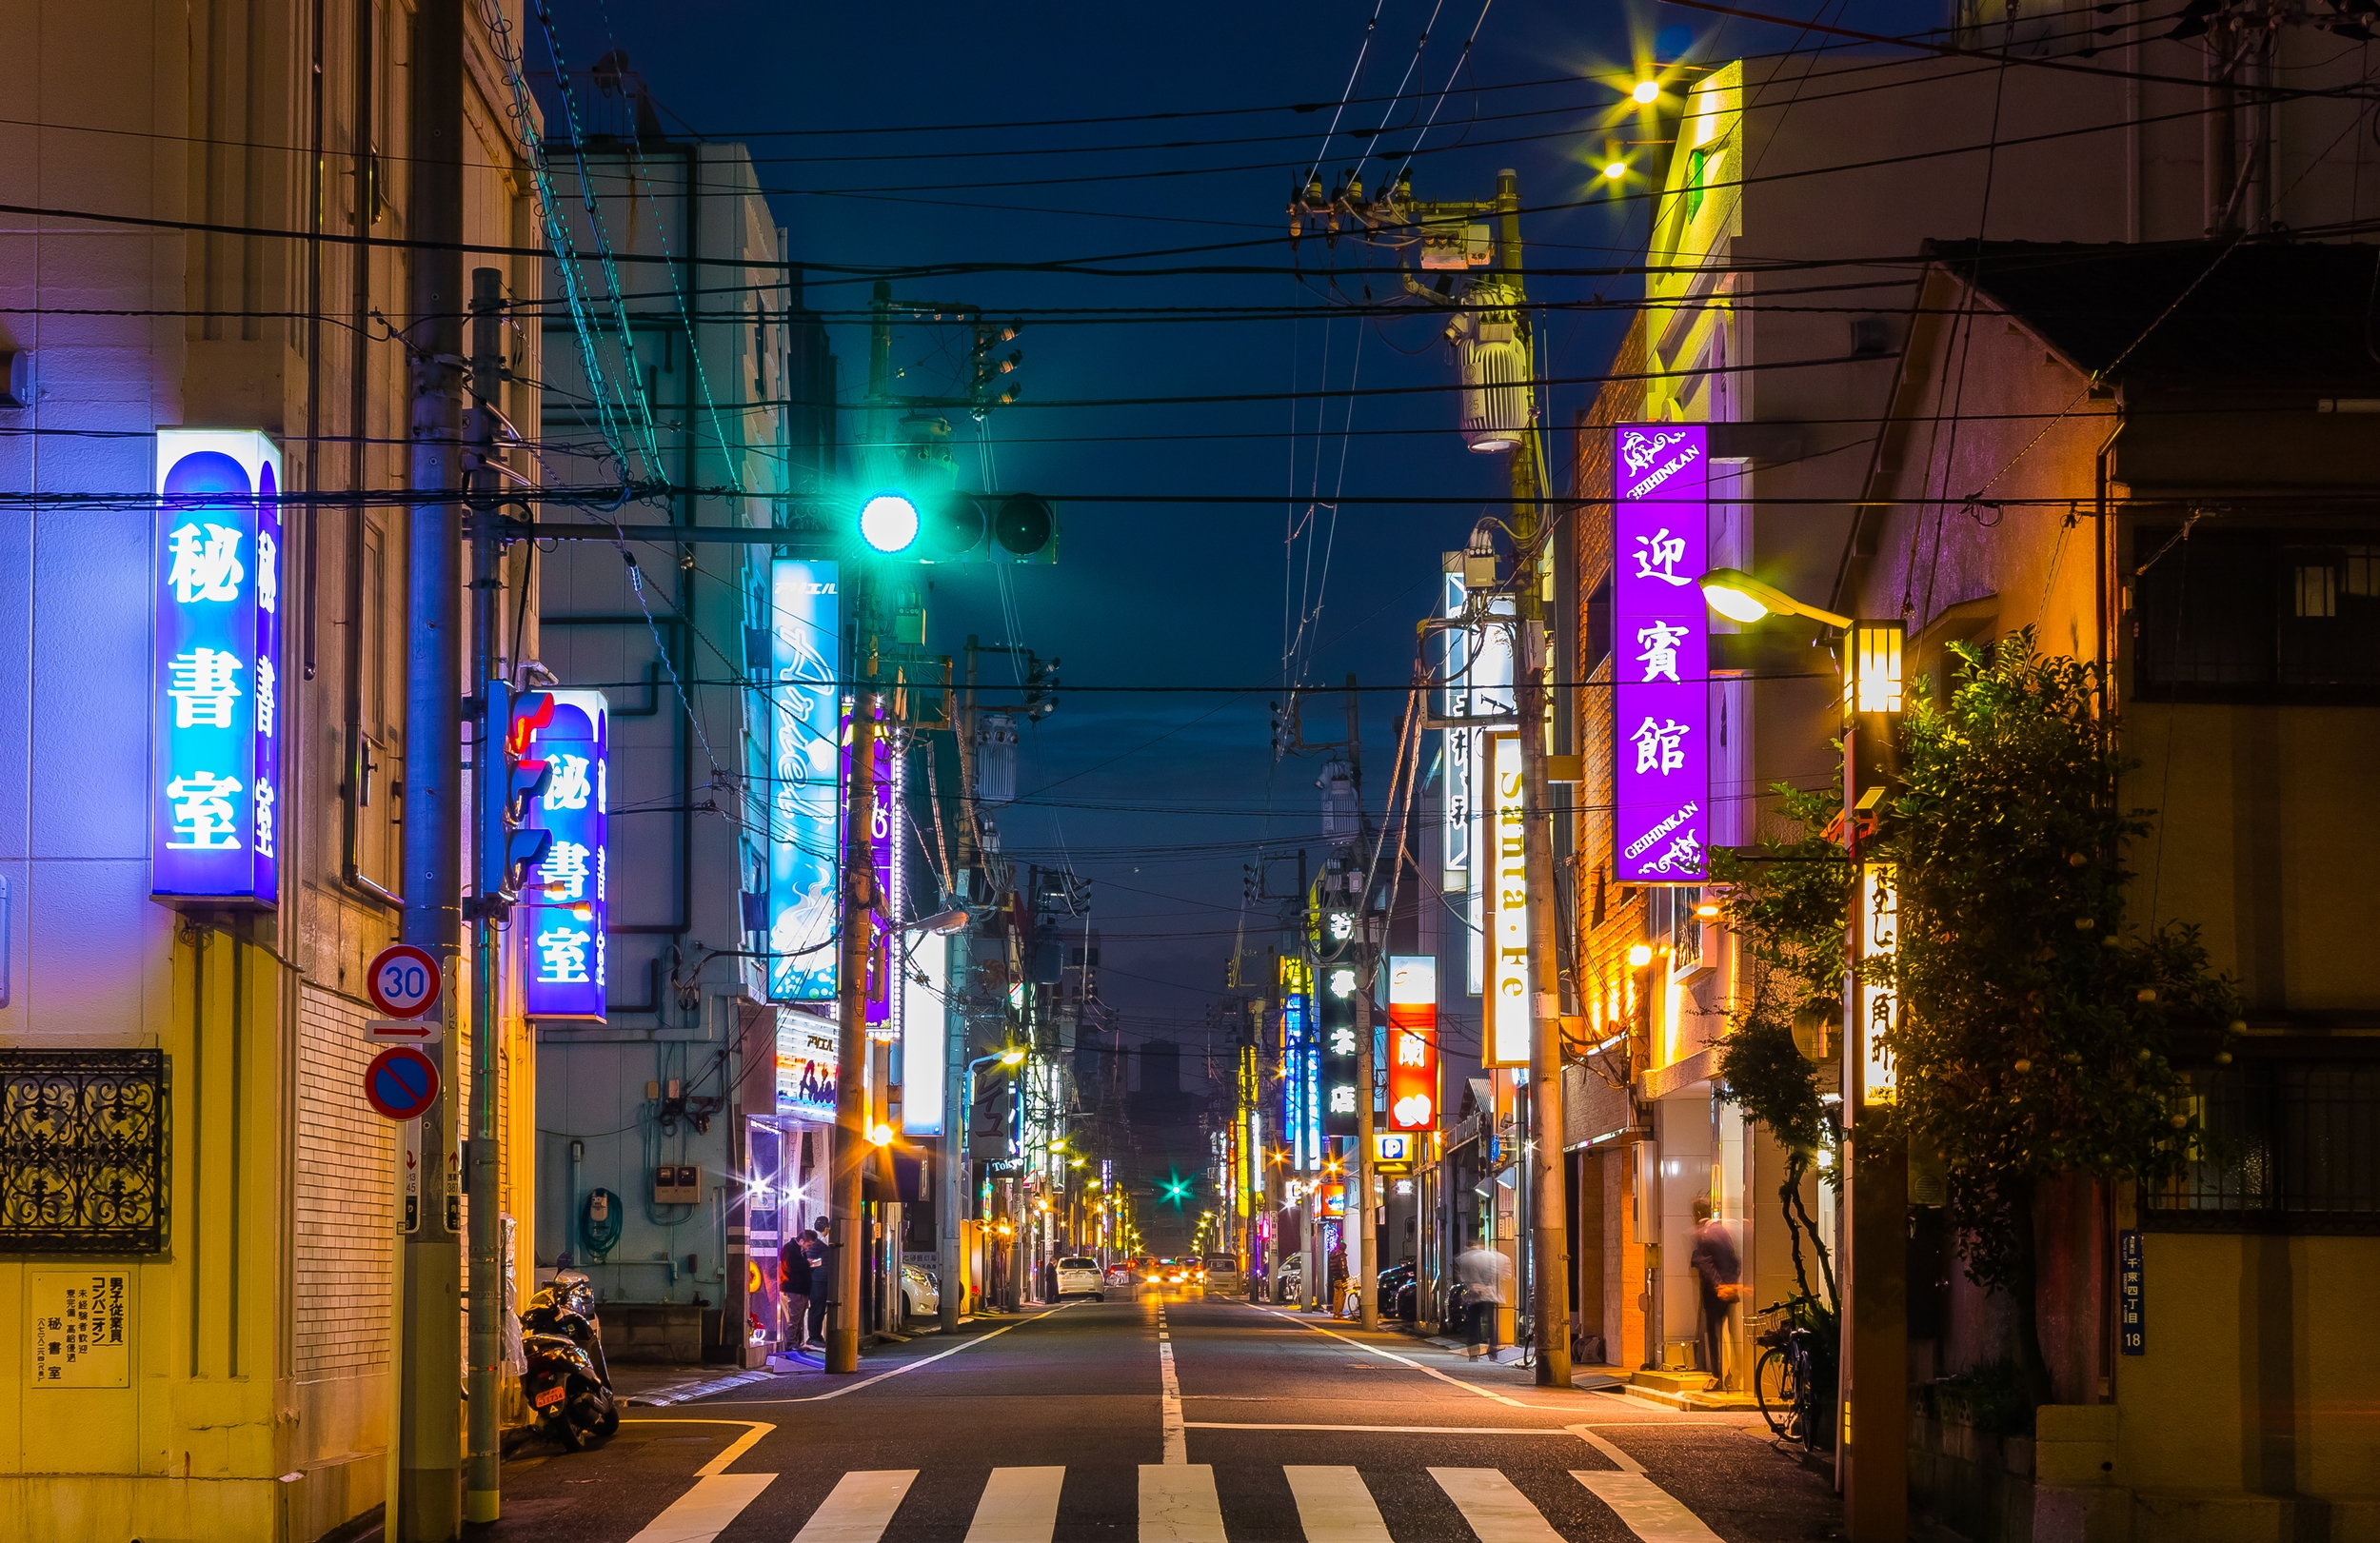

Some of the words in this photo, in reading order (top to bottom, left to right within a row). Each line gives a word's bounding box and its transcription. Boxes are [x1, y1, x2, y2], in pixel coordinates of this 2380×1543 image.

[1626, 444, 1700, 501] GEIHINKAN
[1630, 528, 1693, 777] 迎賓館
[166, 523, 245, 850] 秘書室
[1624, 800, 1699, 860] GEIHINKAN
[537, 753, 592, 983] 秘書室
[385, 966, 425, 999] 30
[992, 1157, 1024, 1173] Tokyo
[1385, 1138, 1401, 1157] P
[78, 1289, 88, 1354] 未経験者歓迎
[91, 1277, 106, 1343] コンパニオン
[109, 1277, 124, 1343] 男子従業員
[2127, 1257, 2139, 1324] 千束四丁目
[48, 1317, 62, 1379] 秘書室
[2126, 1334, 2141, 1347] 18
